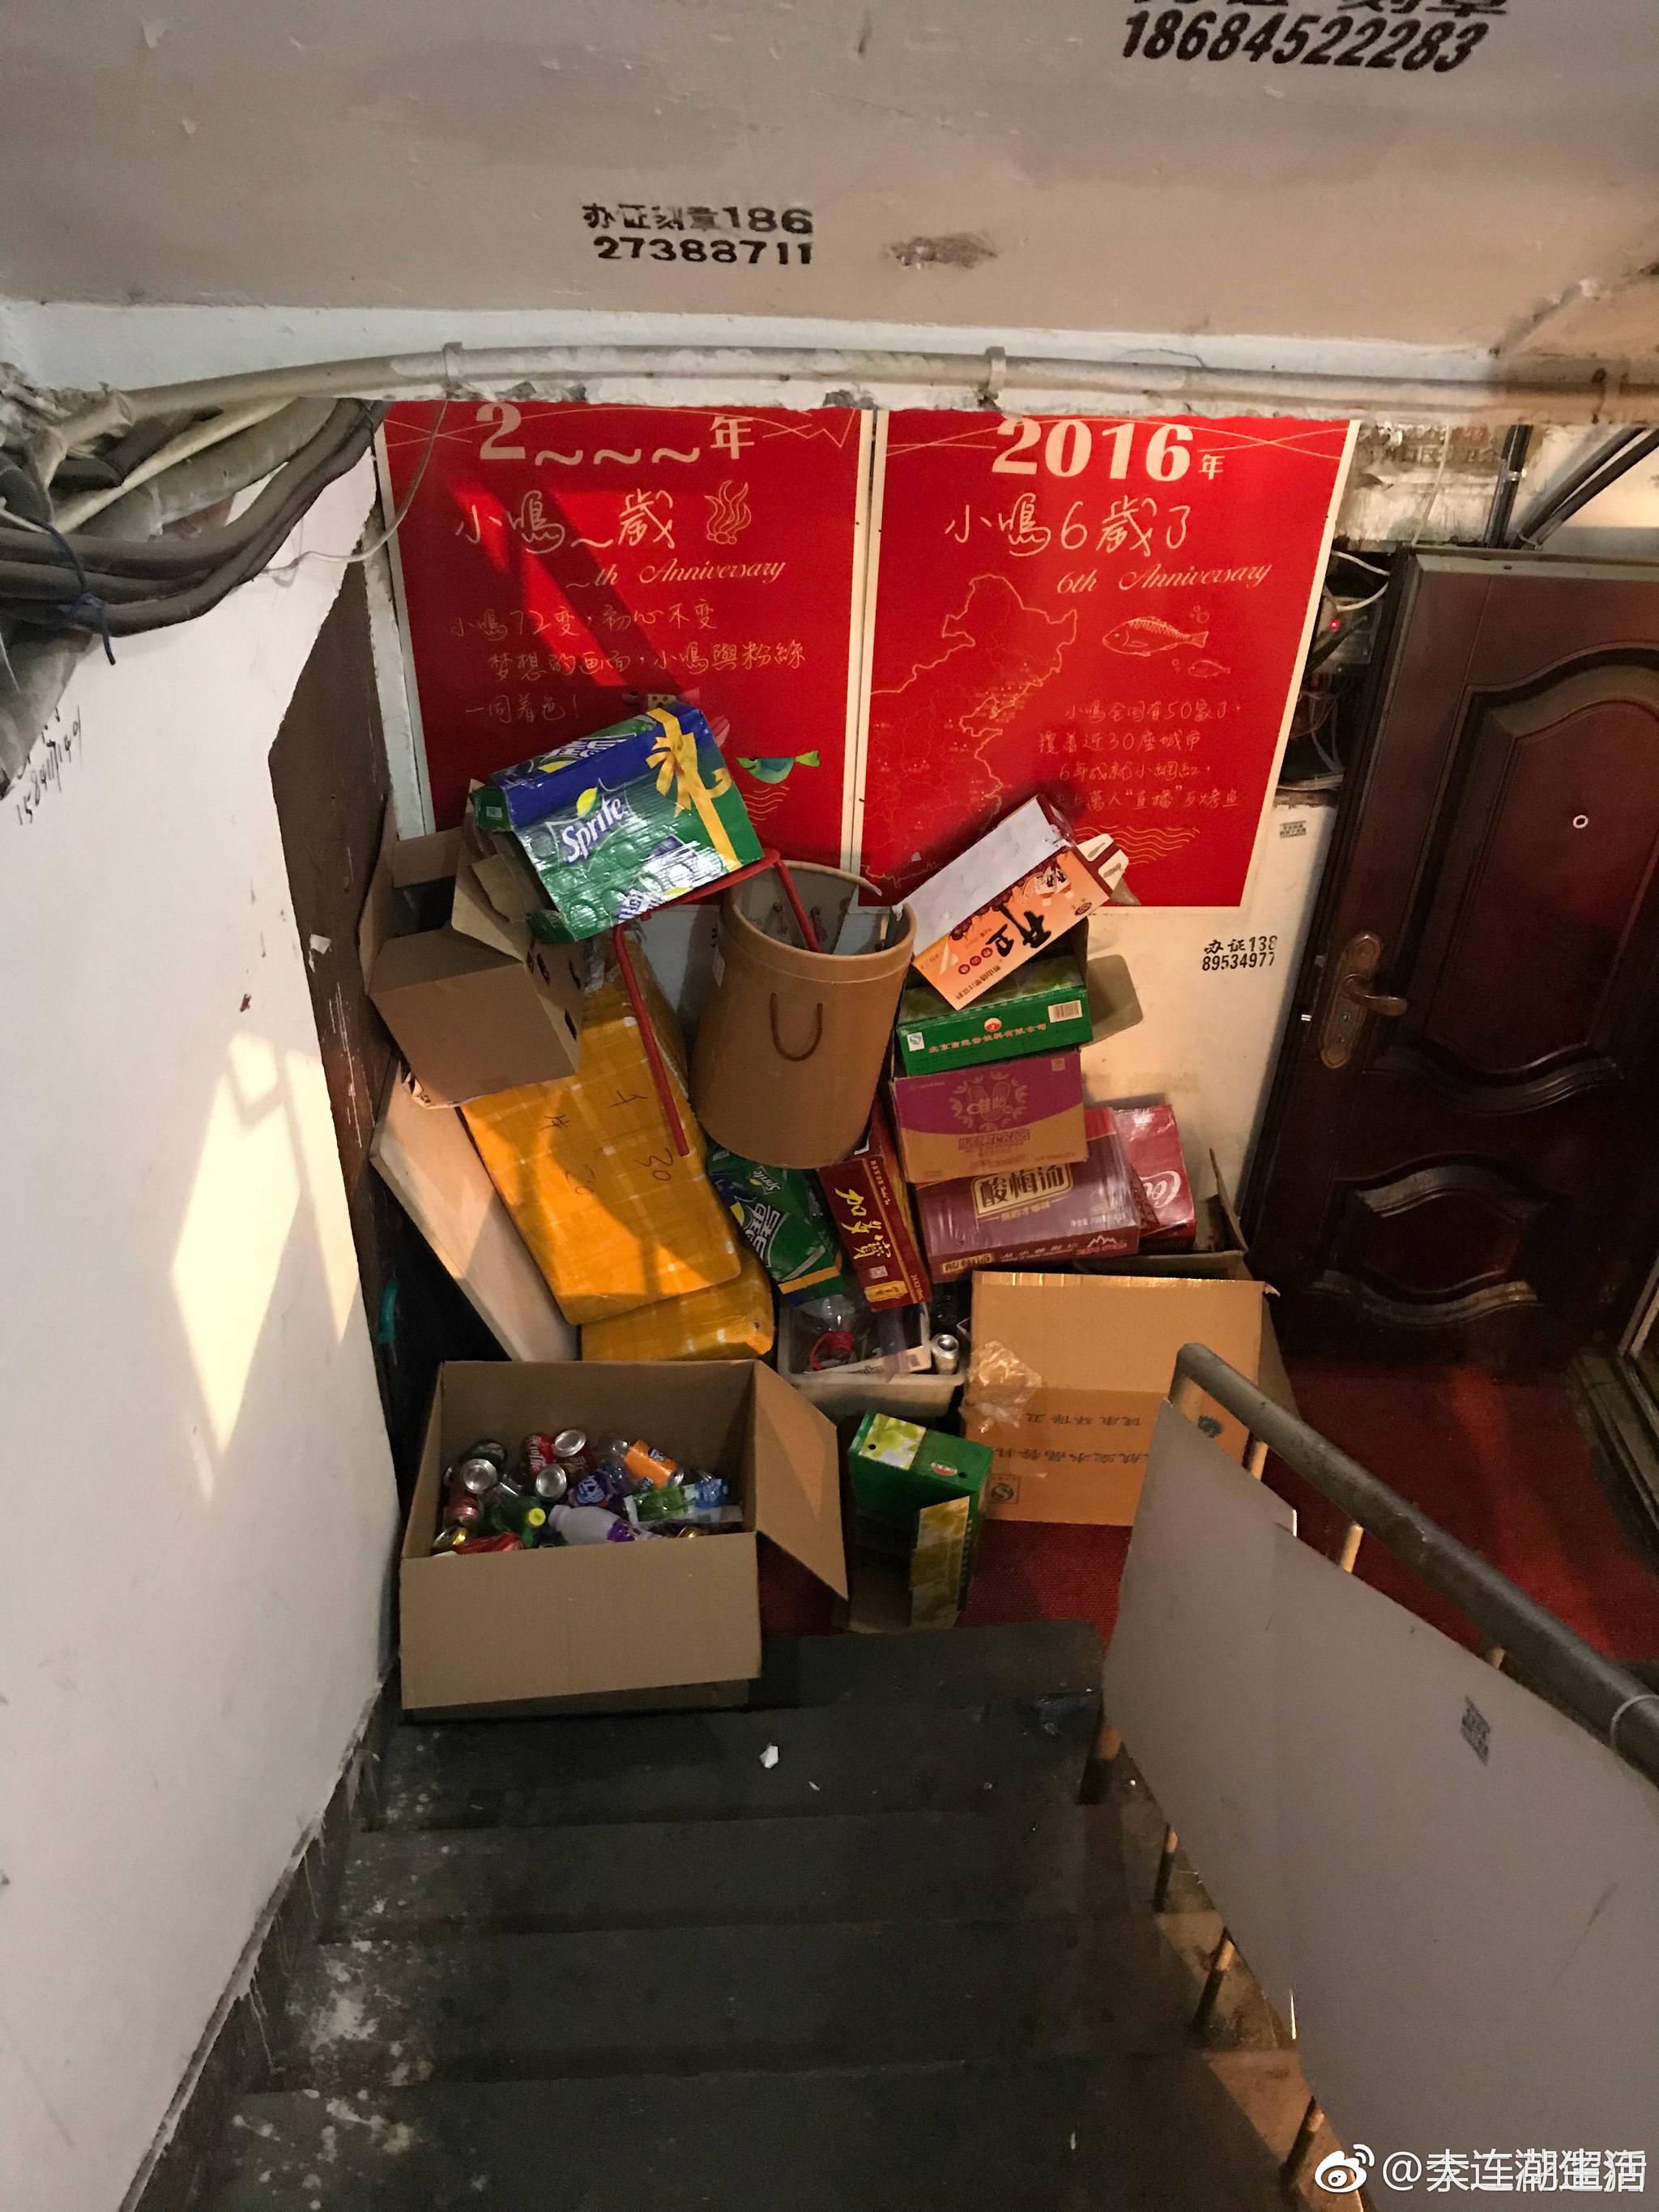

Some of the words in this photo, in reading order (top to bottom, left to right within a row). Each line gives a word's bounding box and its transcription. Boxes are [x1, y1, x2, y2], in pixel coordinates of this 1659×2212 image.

[1122, 10, 1490, 73] 18684522283
[593, 236, 812, 264] 27388711
[639, 558, 787, 585] Anniversary
[1056, 569, 1098, 595] 6th
[1118, 561, 1274, 592] Anniversary
[560, 795, 627, 863] Sprite
[1201, 952, 1275, 971] 89534977
